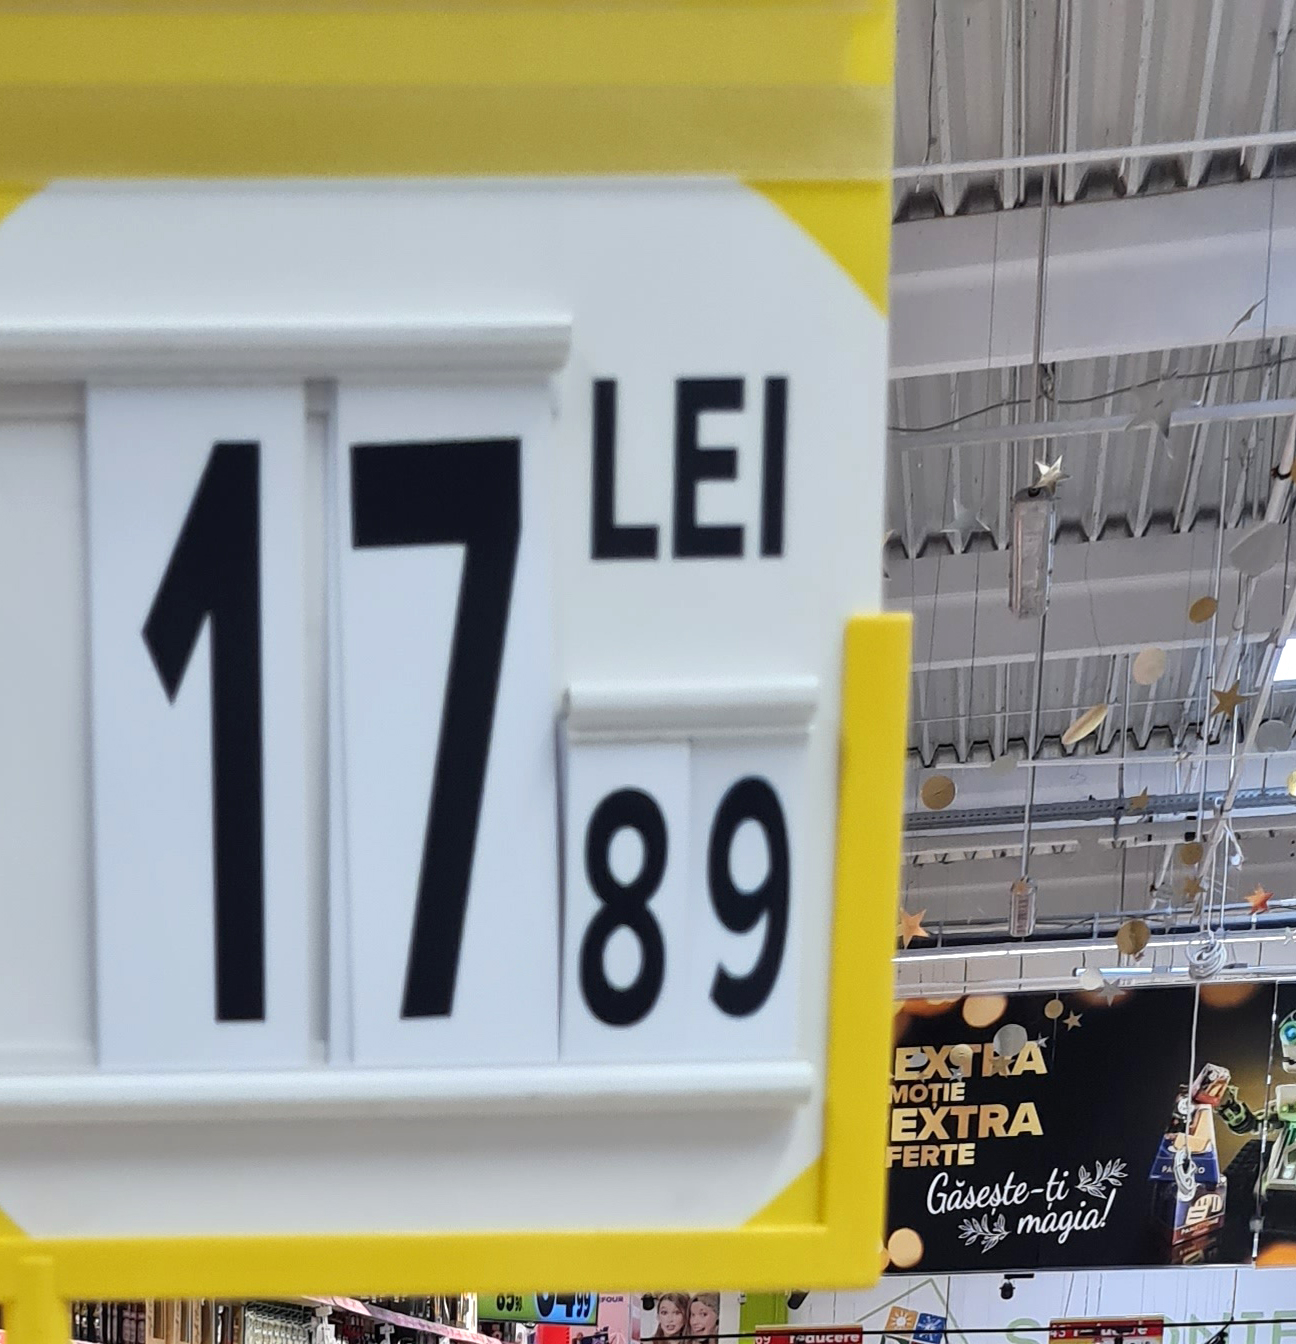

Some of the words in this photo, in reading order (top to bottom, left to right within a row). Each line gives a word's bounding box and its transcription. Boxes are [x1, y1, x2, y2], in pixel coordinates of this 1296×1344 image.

[589, 376, 789, 559] LEI
[141, 436, 522, 1023] 17
[577, 775, 791, 1026] 89
[890, 1101, 1044, 1142] EXTRA
[926, 1167, 1070, 1216] Găsește-ți
[1017, 1188, 1116, 1244] magia!
[575, 1294, 590, 1318] 99
